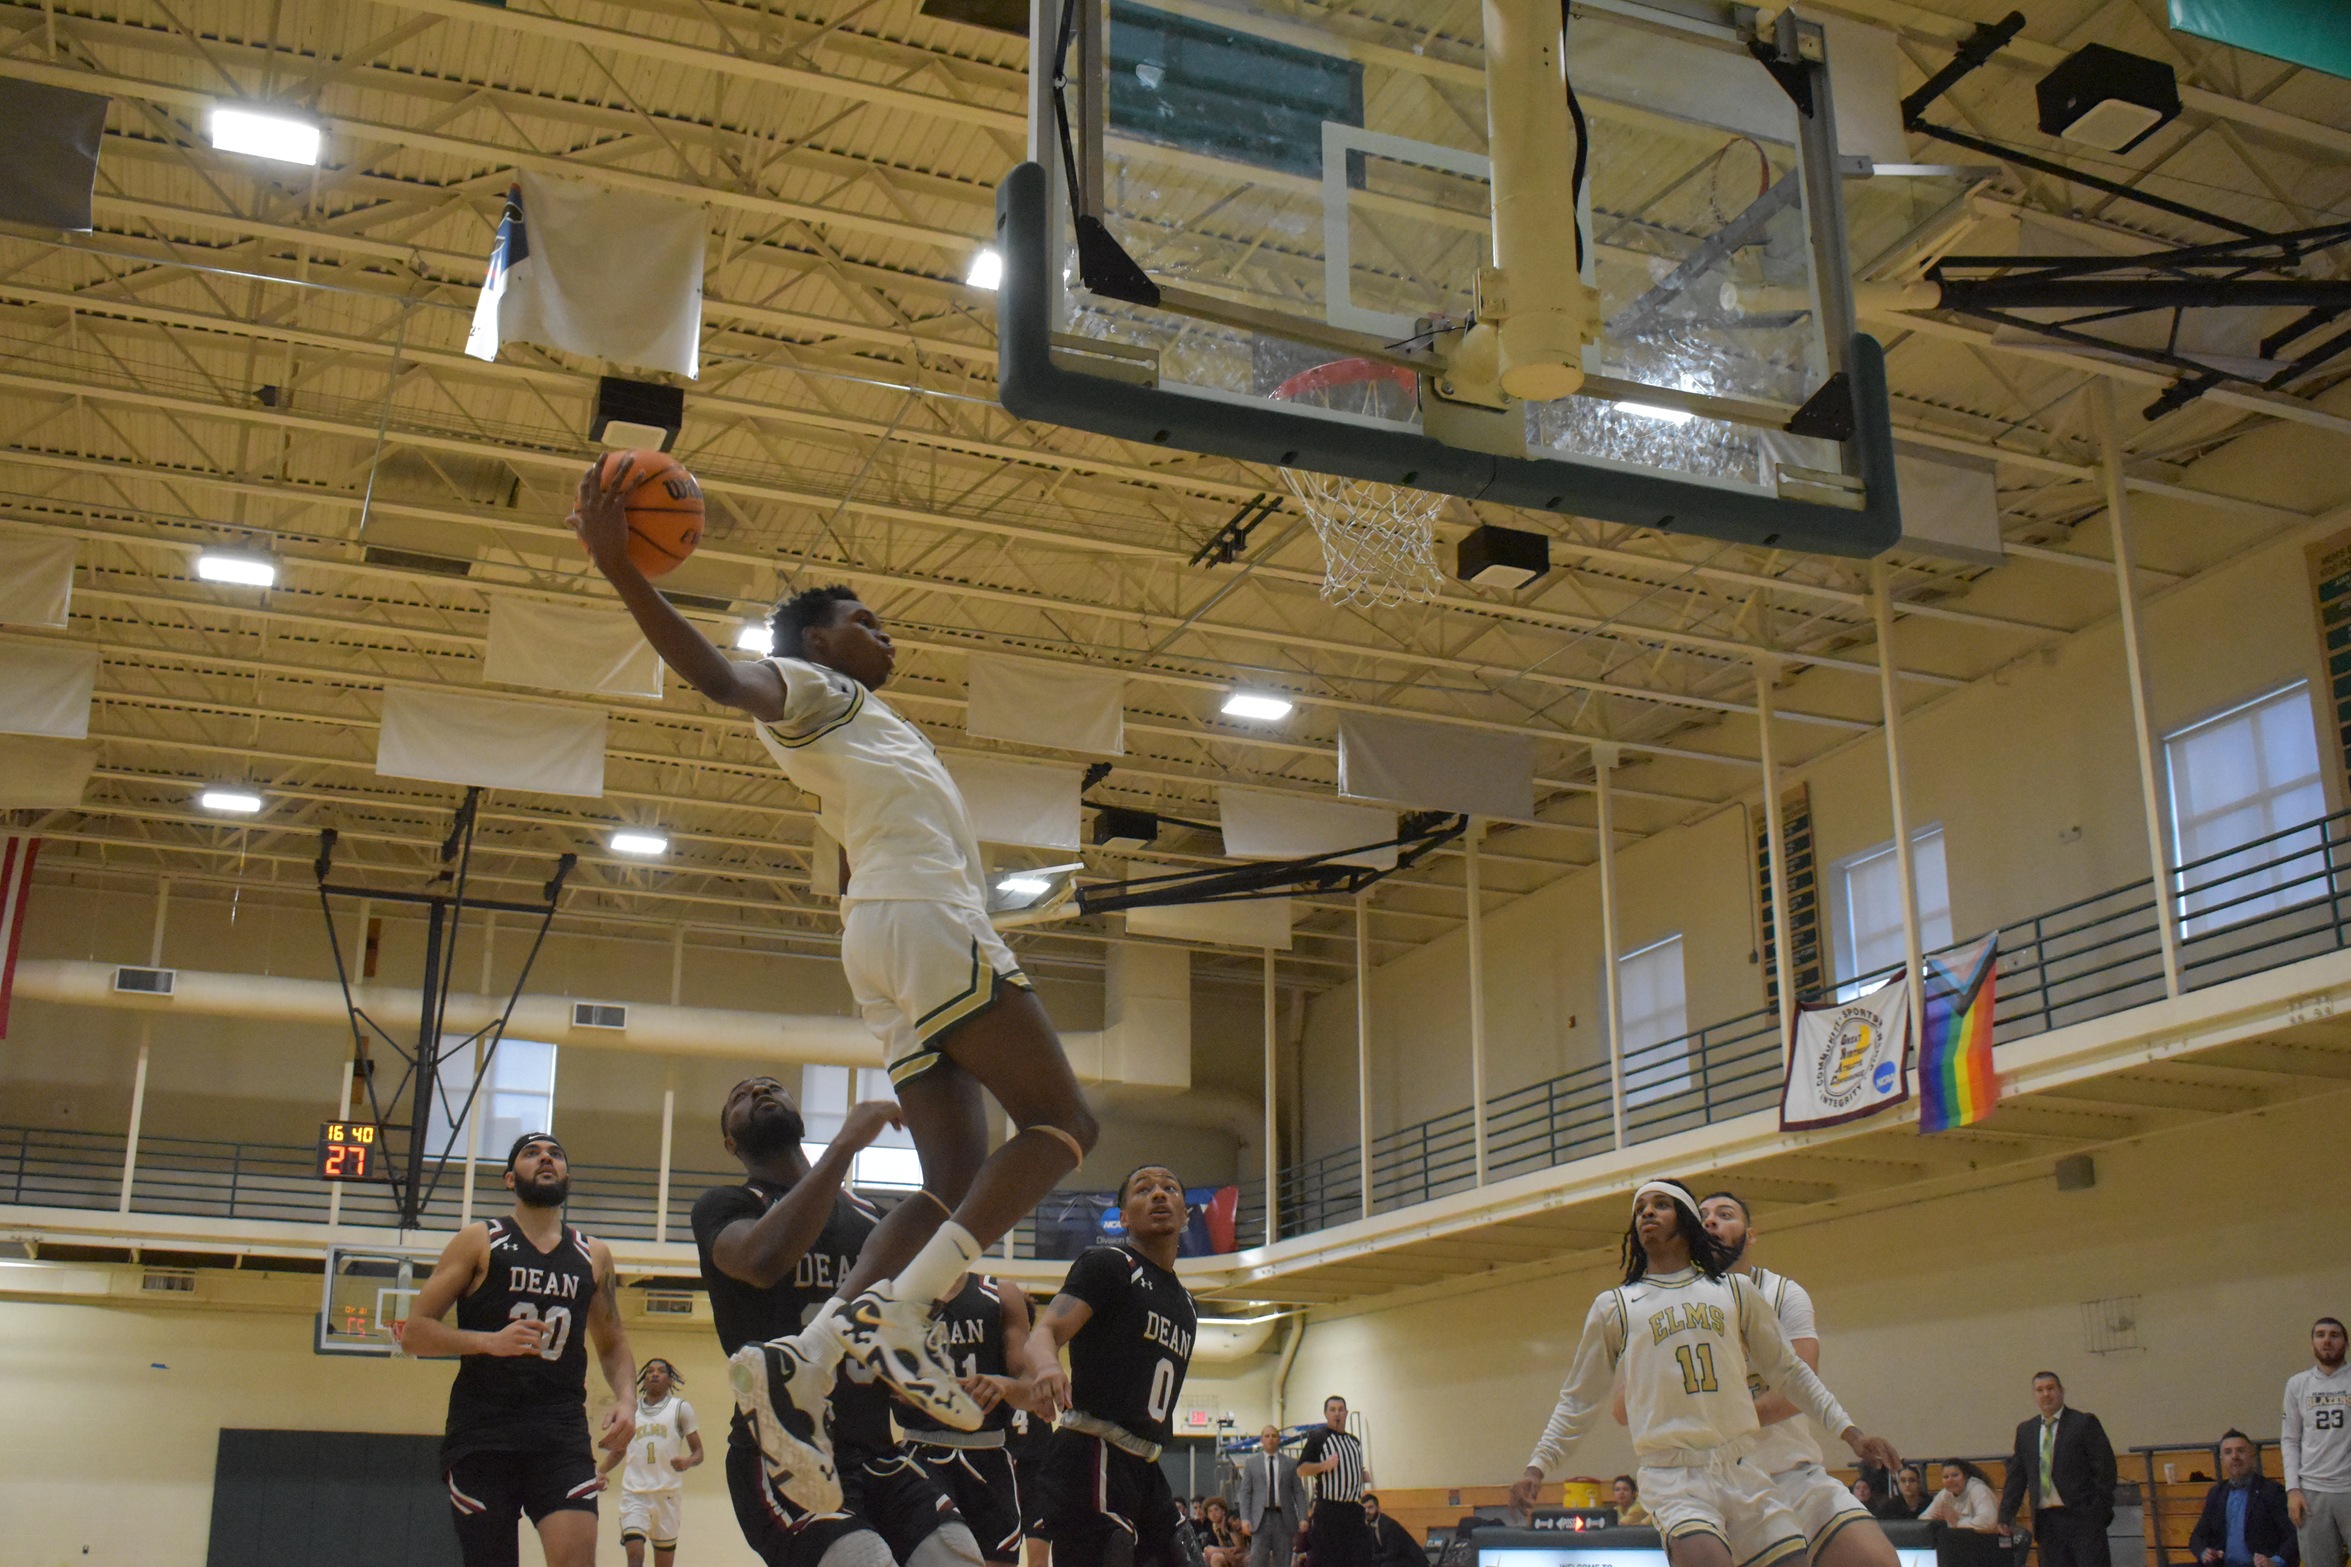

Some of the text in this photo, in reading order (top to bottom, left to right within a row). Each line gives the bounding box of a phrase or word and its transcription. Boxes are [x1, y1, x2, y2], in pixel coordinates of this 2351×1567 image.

[328, 1124, 375, 1144] 16 40
[325, 1145, 367, 1177] 27
[1103, 1220, 1122, 1229] NCA
[508, 1265, 580, 1300] DEAN
[794, 1252, 861, 1289] DEA
[949, 1318, 985, 1345] AN
[1143, 1309, 1192, 1362] DEAN
[1648, 1301, 1726, 1347] ELMS
[1675, 1342, 1719, 1395] 11
[1147, 1356, 1175, 1424] 0
[2315, 1409, 2345, 1430] 23
[646, 1441, 656, 1465] 1
